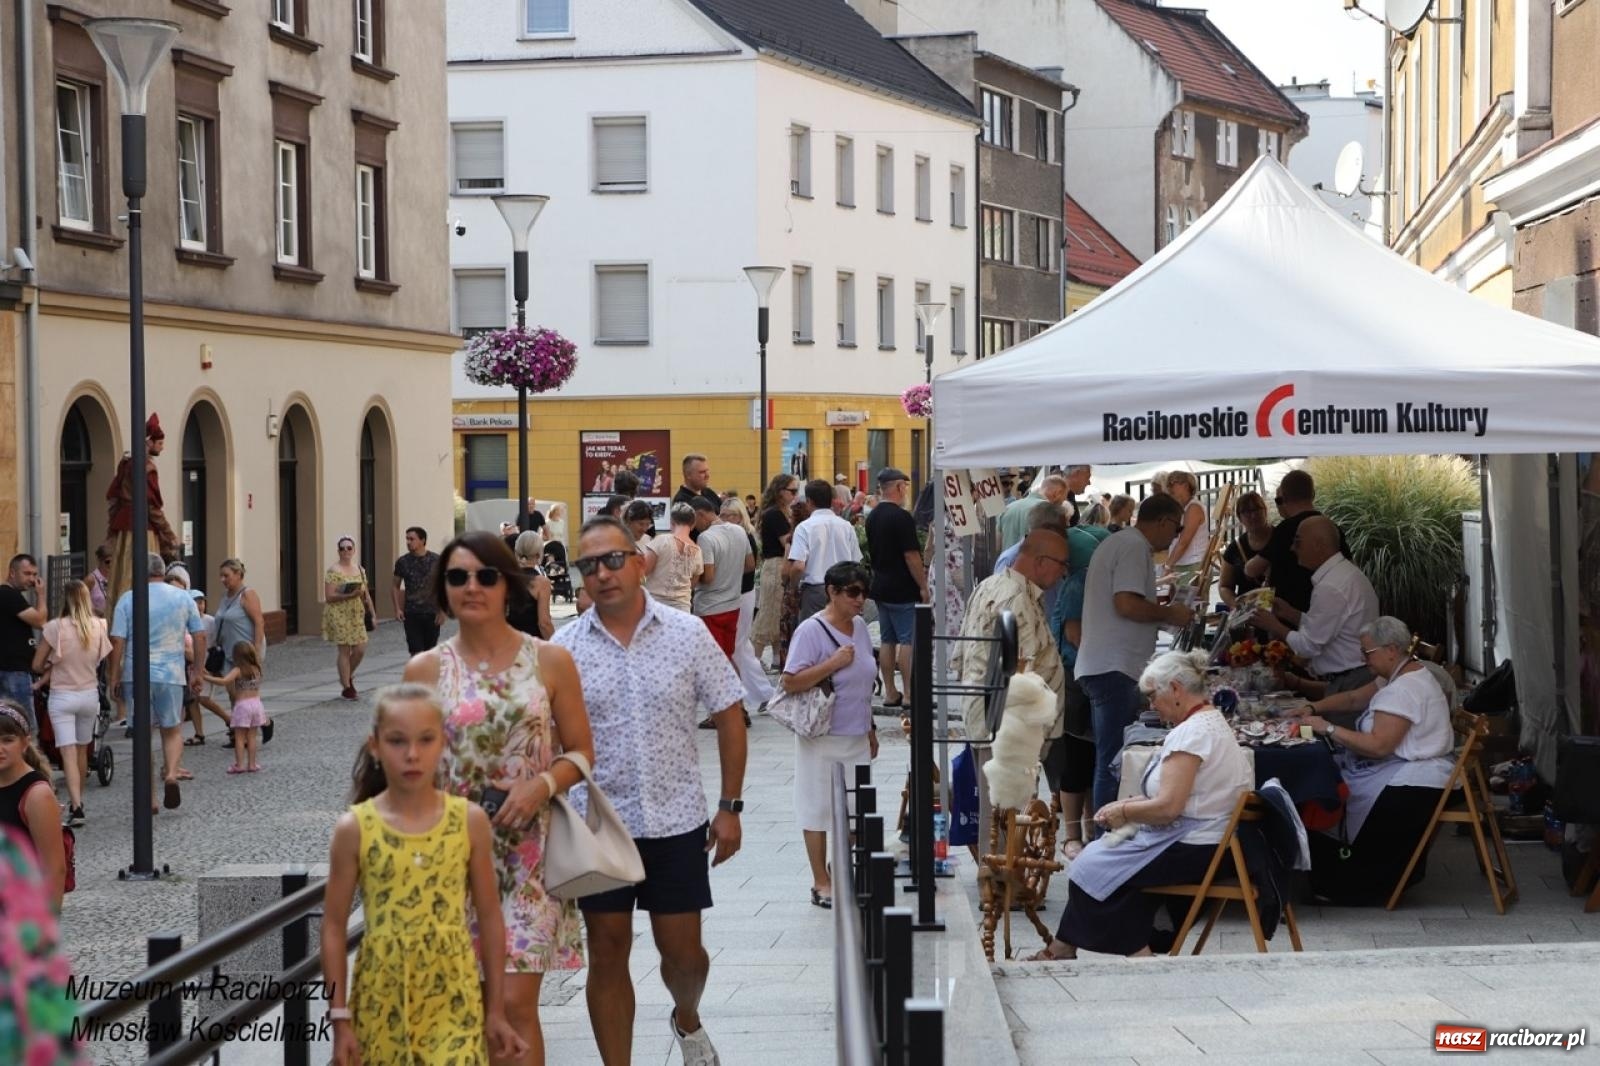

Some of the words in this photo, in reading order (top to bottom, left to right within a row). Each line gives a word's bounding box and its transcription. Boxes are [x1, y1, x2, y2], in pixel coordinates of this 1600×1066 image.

[469, 418, 488, 426] Bank
[490, 418, 512, 426] Pekao
[1103, 406, 1248, 442] Raciborskie
[1396, 402, 1489, 437] Kultury
